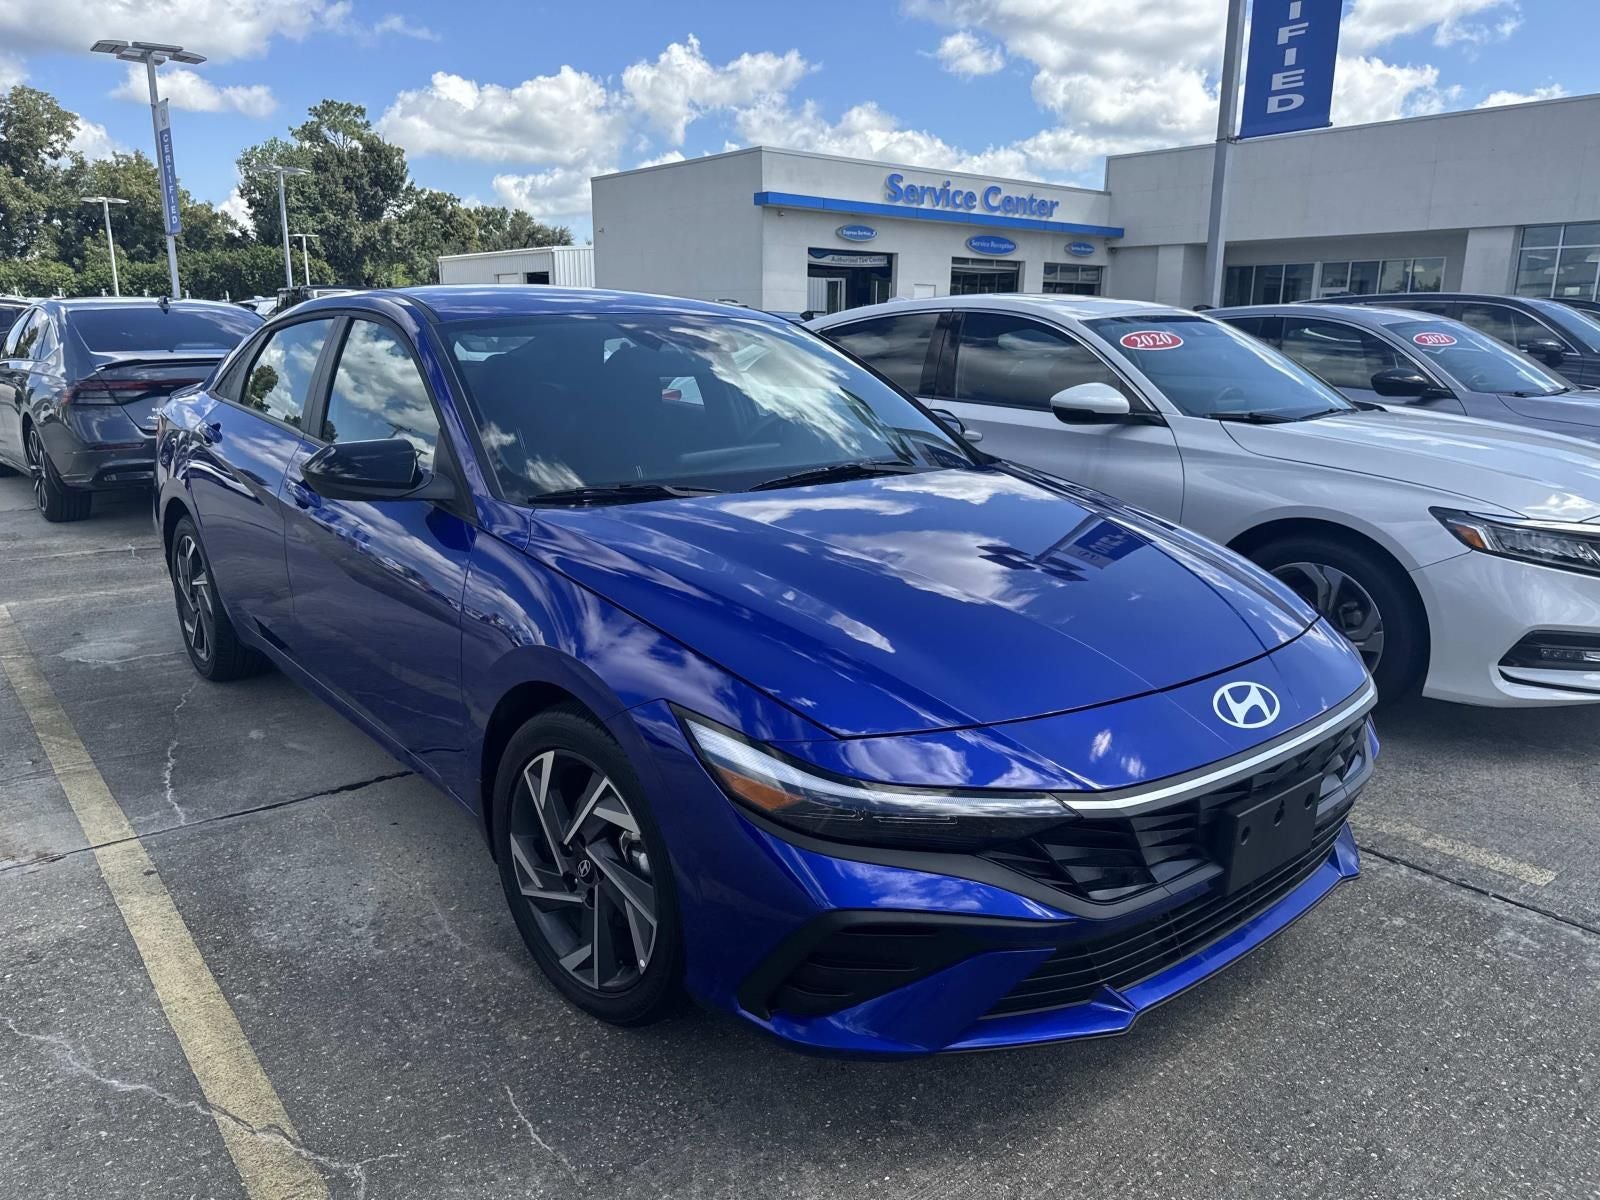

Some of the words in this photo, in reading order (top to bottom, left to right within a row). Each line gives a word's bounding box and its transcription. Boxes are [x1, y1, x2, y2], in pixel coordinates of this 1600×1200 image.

[162, 133, 178, 224] CERTIFIED
[886, 173, 977, 210] Service
[983, 185, 1060, 218] Center
[971, 239, 990, 248] Service
[990, 240, 1014, 250] Rption
[1130, 334, 1172, 347] 2020
[1421, 334, 1450, 344] 2021
